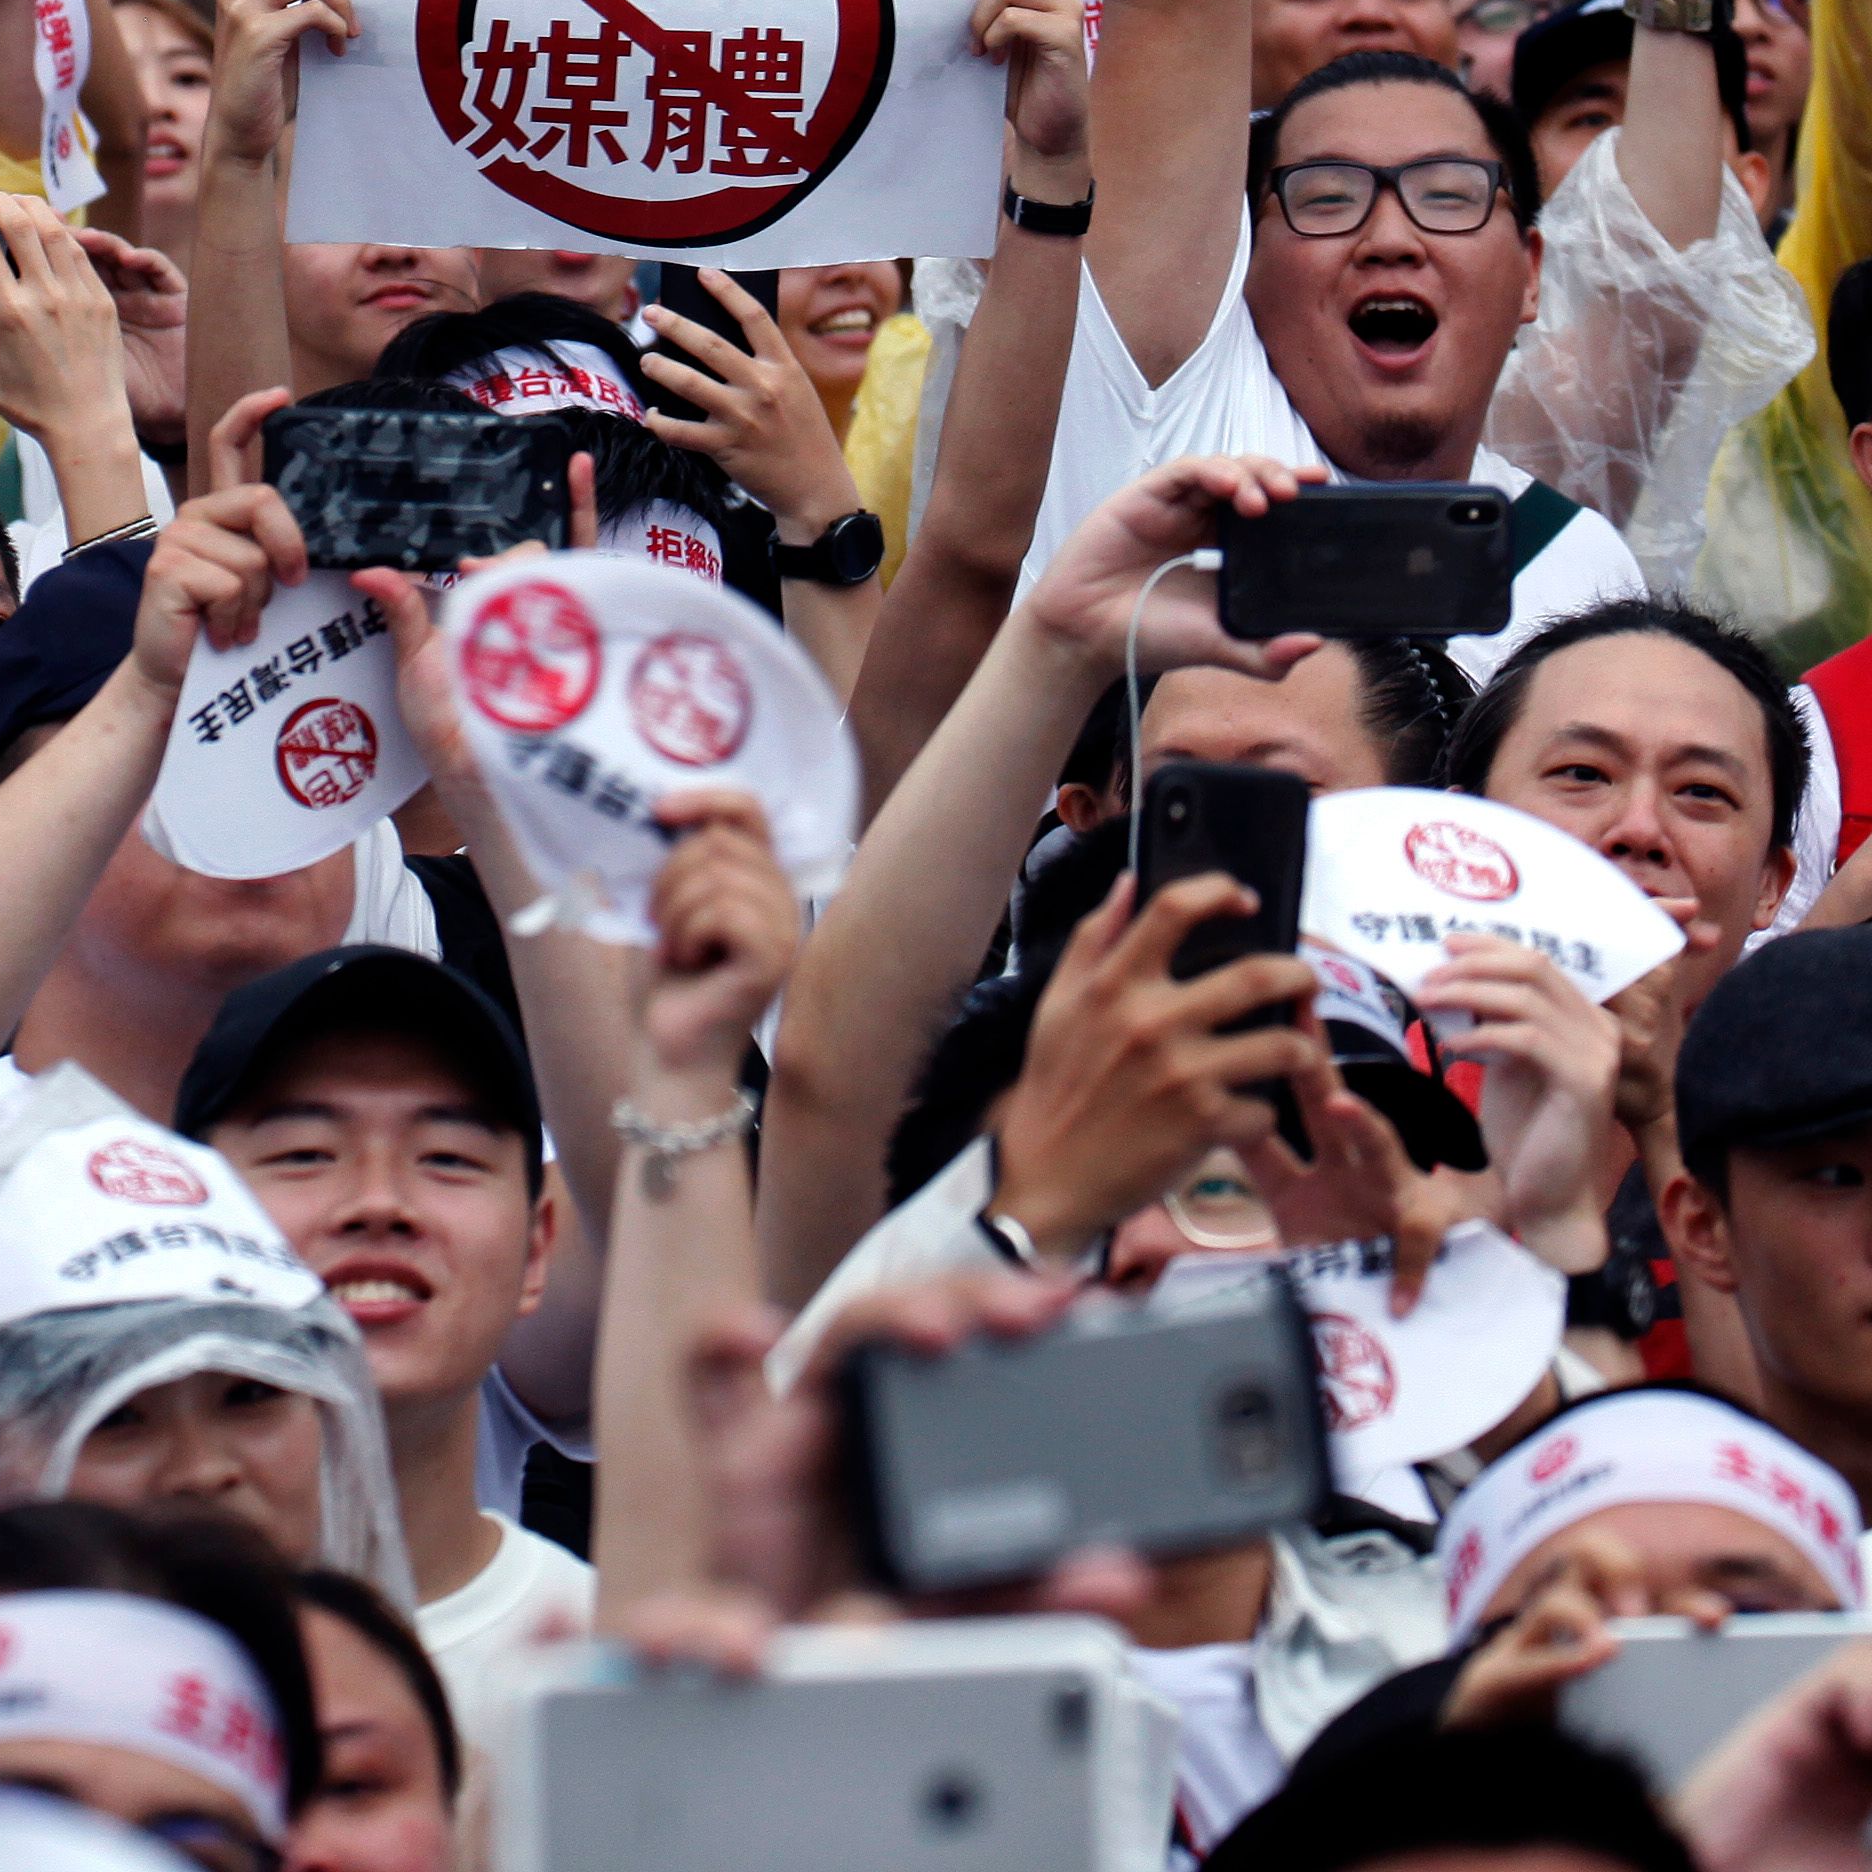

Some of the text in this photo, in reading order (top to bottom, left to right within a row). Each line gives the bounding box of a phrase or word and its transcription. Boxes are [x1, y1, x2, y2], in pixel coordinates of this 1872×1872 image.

[466, 18, 810, 178] 媒體
[188, 604, 388, 745] 守護台灣民主
